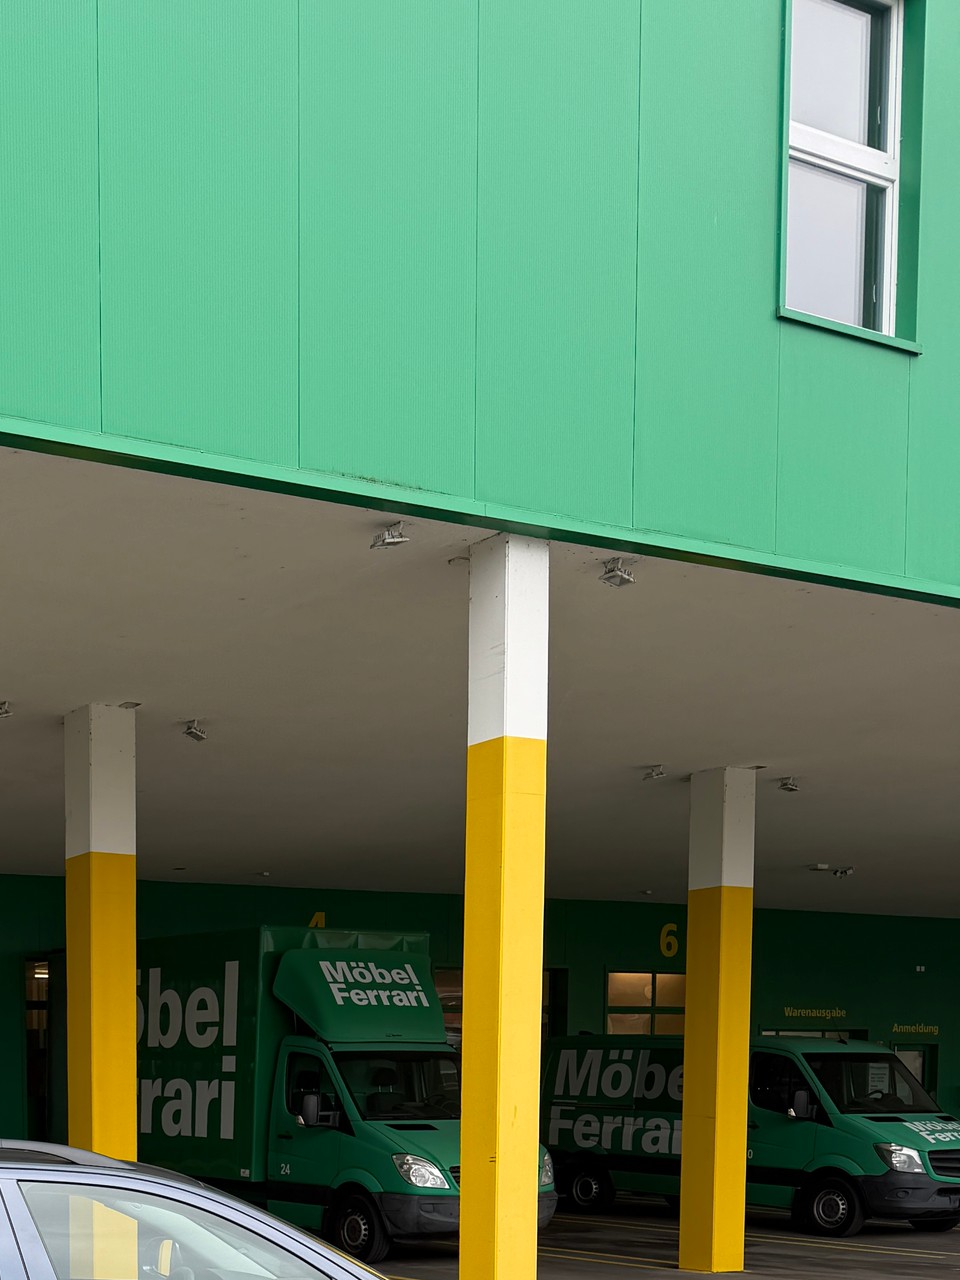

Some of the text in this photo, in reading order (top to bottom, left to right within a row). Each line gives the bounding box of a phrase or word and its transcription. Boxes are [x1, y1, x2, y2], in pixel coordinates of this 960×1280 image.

[660, 922, 679, 958] 6
[319, 960, 420, 985] Möbel
[136, 960, 240, 1049] bel
[328, 982, 430, 1008] Ferrari
[783, 1006, 847, 1020] Warenausgabe
[892, 1023, 939, 1036] Anmeldung
[554, 1050, 684, 1100] Möbe
[137, 1055, 237, 1140] rari
[548, 1099, 683, 1155] Ferra
[919, 1131, 960, 1144] Ferr
[280, 1163, 291, 1175] 24
